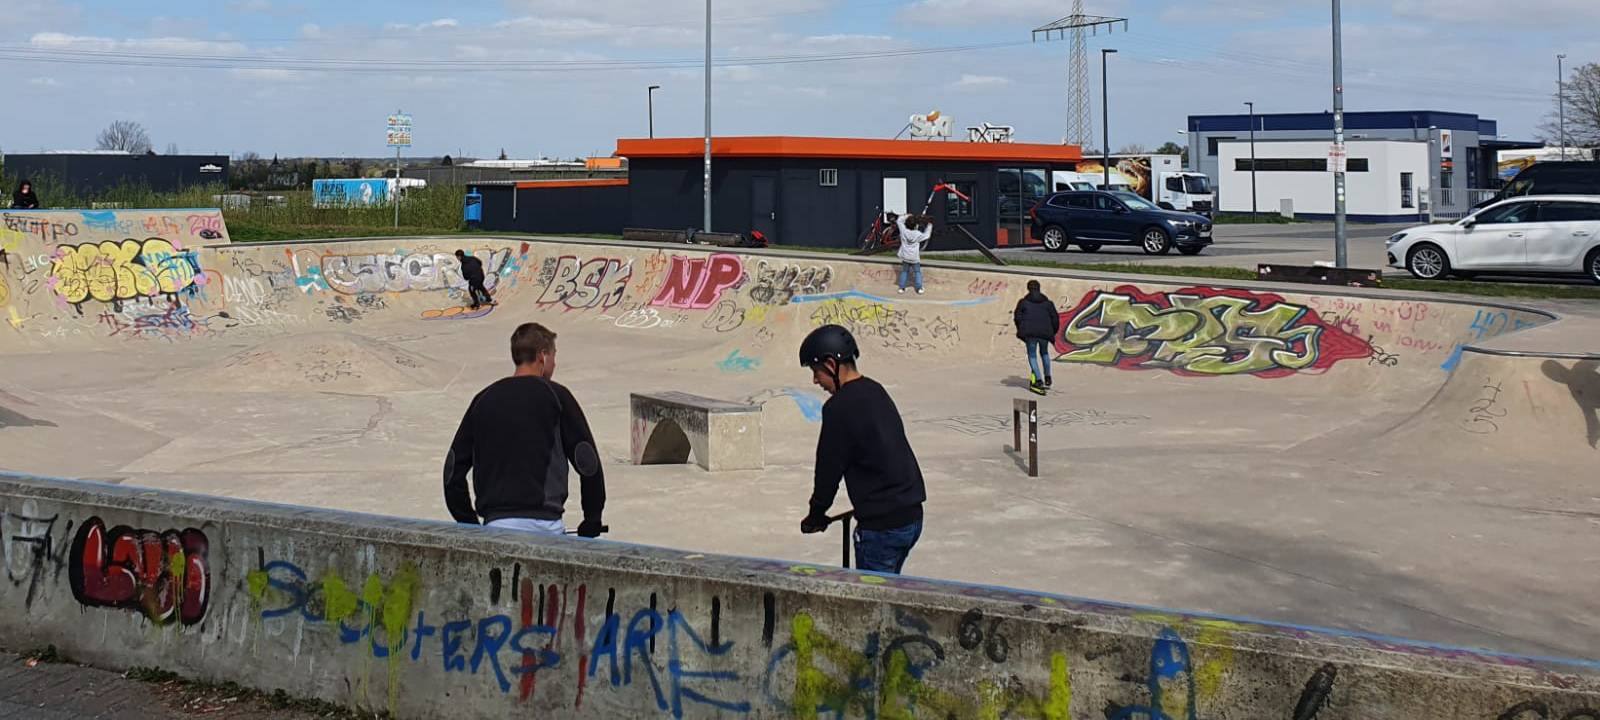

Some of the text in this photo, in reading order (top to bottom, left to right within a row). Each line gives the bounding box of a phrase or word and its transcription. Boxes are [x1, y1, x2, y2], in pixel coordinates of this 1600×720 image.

[536, 255, 633, 309] BSK
[649, 251, 744, 310] NP
[588, 607, 752, 719] ARE
